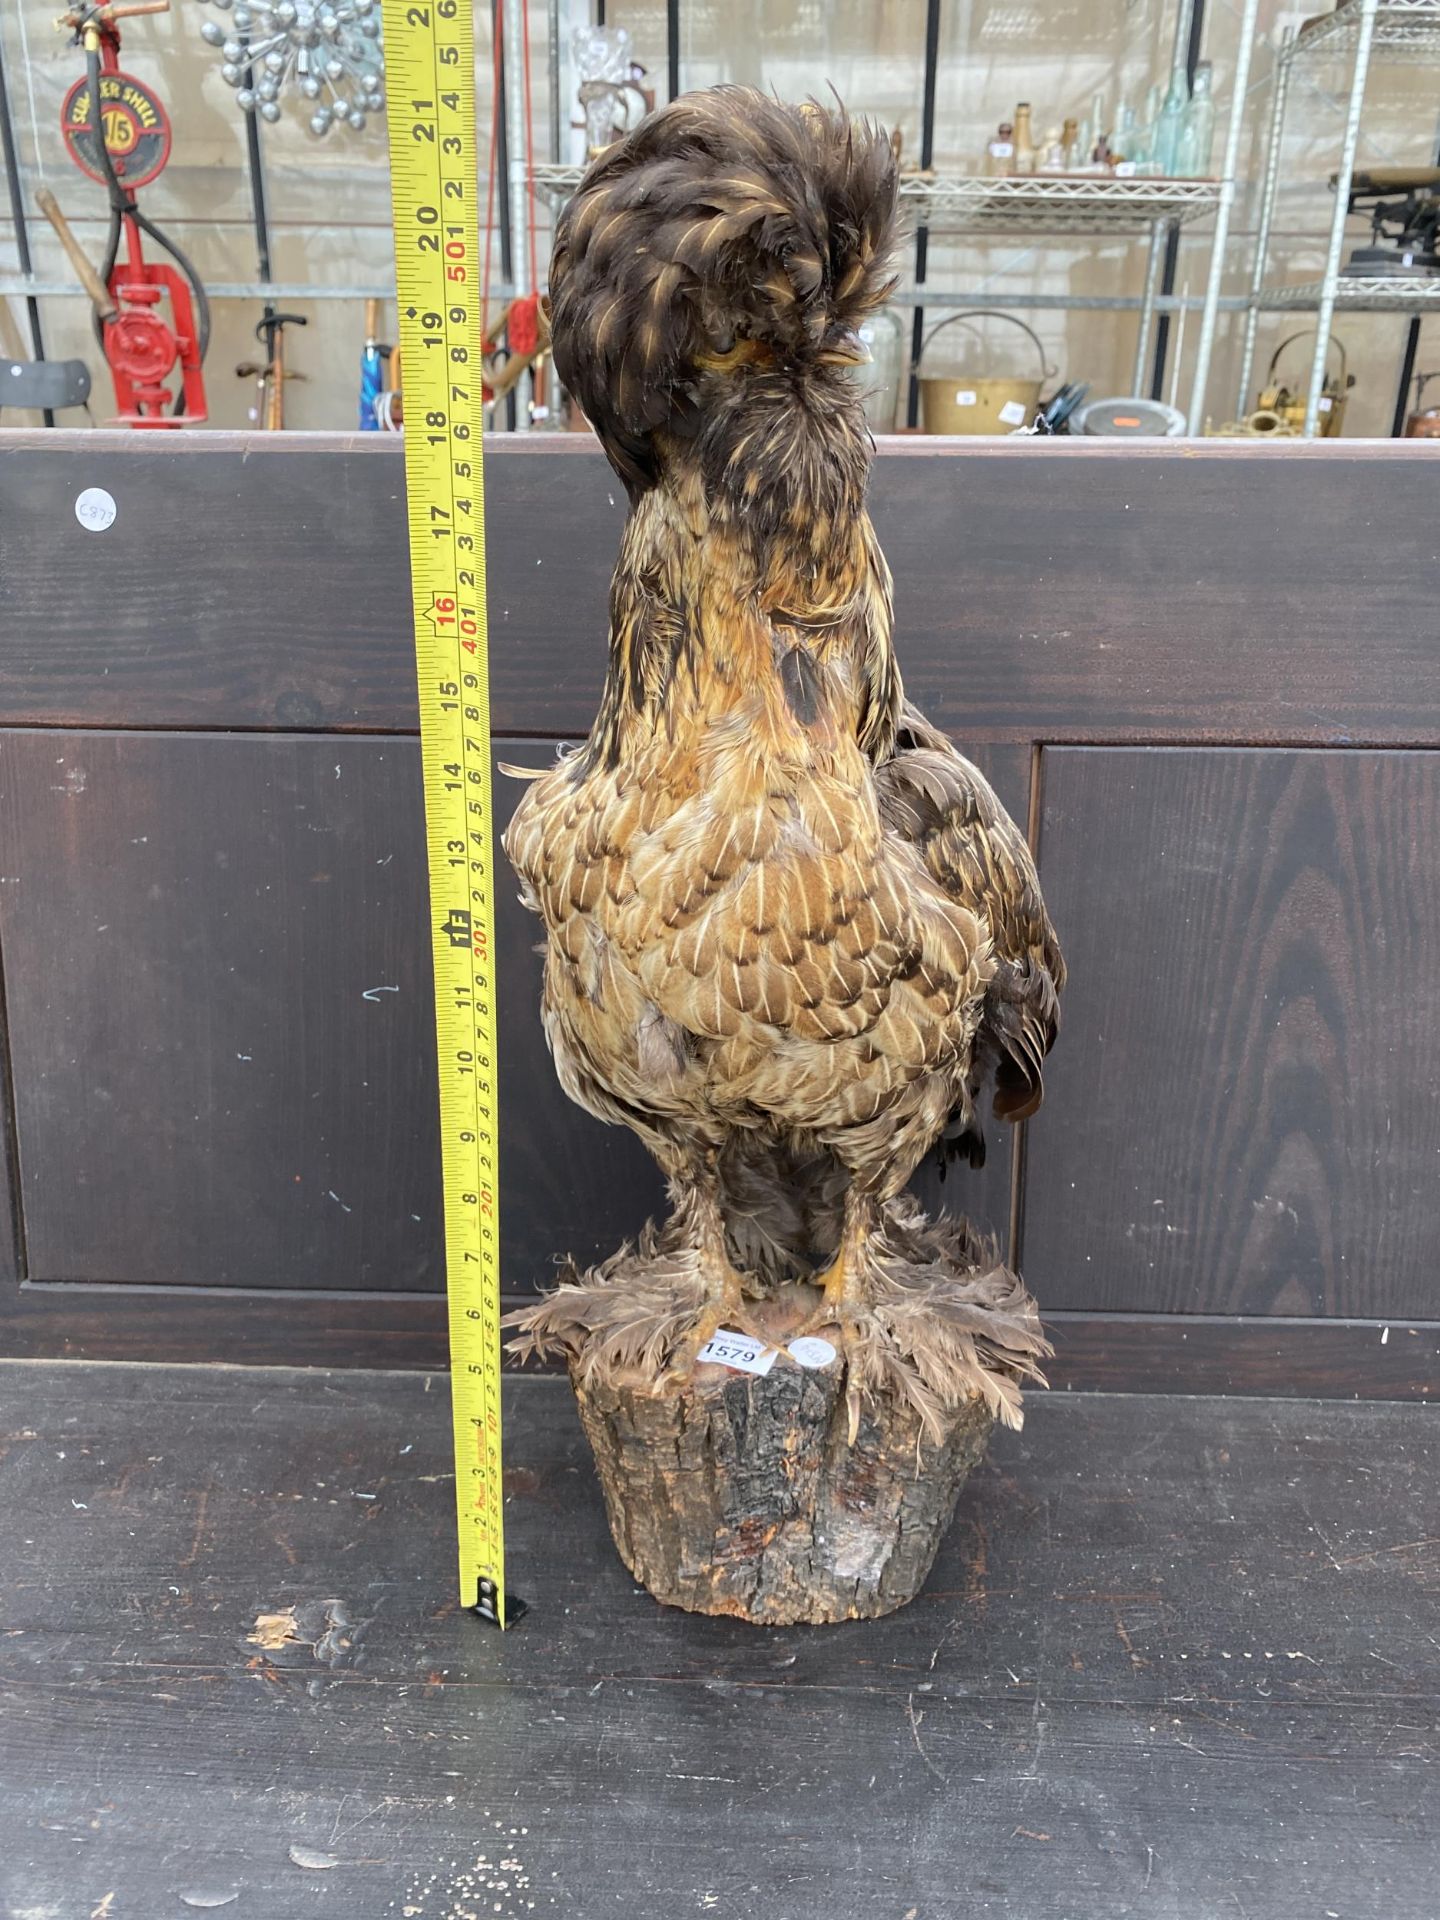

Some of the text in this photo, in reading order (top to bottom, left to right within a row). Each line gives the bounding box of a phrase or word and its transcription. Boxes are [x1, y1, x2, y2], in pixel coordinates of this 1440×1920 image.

[437, 0, 457, 19] 6
[440, 47, 458, 65] 5
[72, 81, 157, 128] SUMER SHELL
[441, 92, 459, 111] 4
[412, 100, 434, 142] 21
[443, 137, 461, 154] 3
[444, 181, 463, 198] 2
[416, 206, 438, 252] 20
[446, 242, 465, 282] 50
[449, 308, 466, 323] 9
[421, 312, 442, 349] 19
[451, 348, 468, 363] 8
[452, 386, 468, 401] 7
[425, 412, 447, 446] 18
[454, 425, 470, 440] 6
[455, 463, 471, 477] 5
[457, 500, 471, 514] 4
[430, 506, 450, 539] 17
[458, 536, 473, 550] 3
[459, 571, 474, 586] 2
[436, 598, 455, 626] 16
[460, 620, 477, 655] 40
[464, 675, 478, 688] 9
[440, 682, 458, 712] 15
[465, 707, 479, 721] 8
[467, 739, 480, 752] 7
[444, 763, 462, 791] 14
[468, 771, 481, 785] 6
[469, 801, 482, 815] 5
[470, 832, 482, 845] 4
[447, 840, 465, 867] 13
[471, 862, 484, 875] 3
[472, 891, 484, 904] 2
[451, 914, 469, 941] 1F
[473, 931, 487, 961] 30
[475, 975, 487, 988] 9
[454, 987, 470, 1008] 11
[476, 1002, 488, 1015] 8
[477, 1029, 488, 1040] 7
[457, 1051, 473, 1074] 10
[478, 1057, 489, 1067] 6
[479, 1081, 490, 1093] 5
[480, 1106, 490, 1118] 4
[460, 1132, 475, 1142] 9
[480, 1132, 491, 1144] 3
[481, 1157, 491, 1170] 2
[462, 1194, 477, 1204] 8
[481, 1191, 493, 1217] 20
[483, 1229, 492, 1241] 9
[465, 1253, 478, 1262] 7
[483, 1251, 493, 1264] 8
[484, 1274, 493, 1287] 7
[485, 1298, 493, 1309] 6
[467, 1309, 480, 1319] 6
[485, 1320, 494, 1333] 5
[485, 1342, 494, 1352] 4
[706, 1342, 755, 1362] 1579
[469, 1366, 482, 1375] 5
[486, 1364, 494, 1375] 3
[487, 1385, 495, 1397] 2
[470, 1418, 483, 1427] 4
[472, 1469, 485, 1477] 3
[474, 1518, 486, 1527] 2
